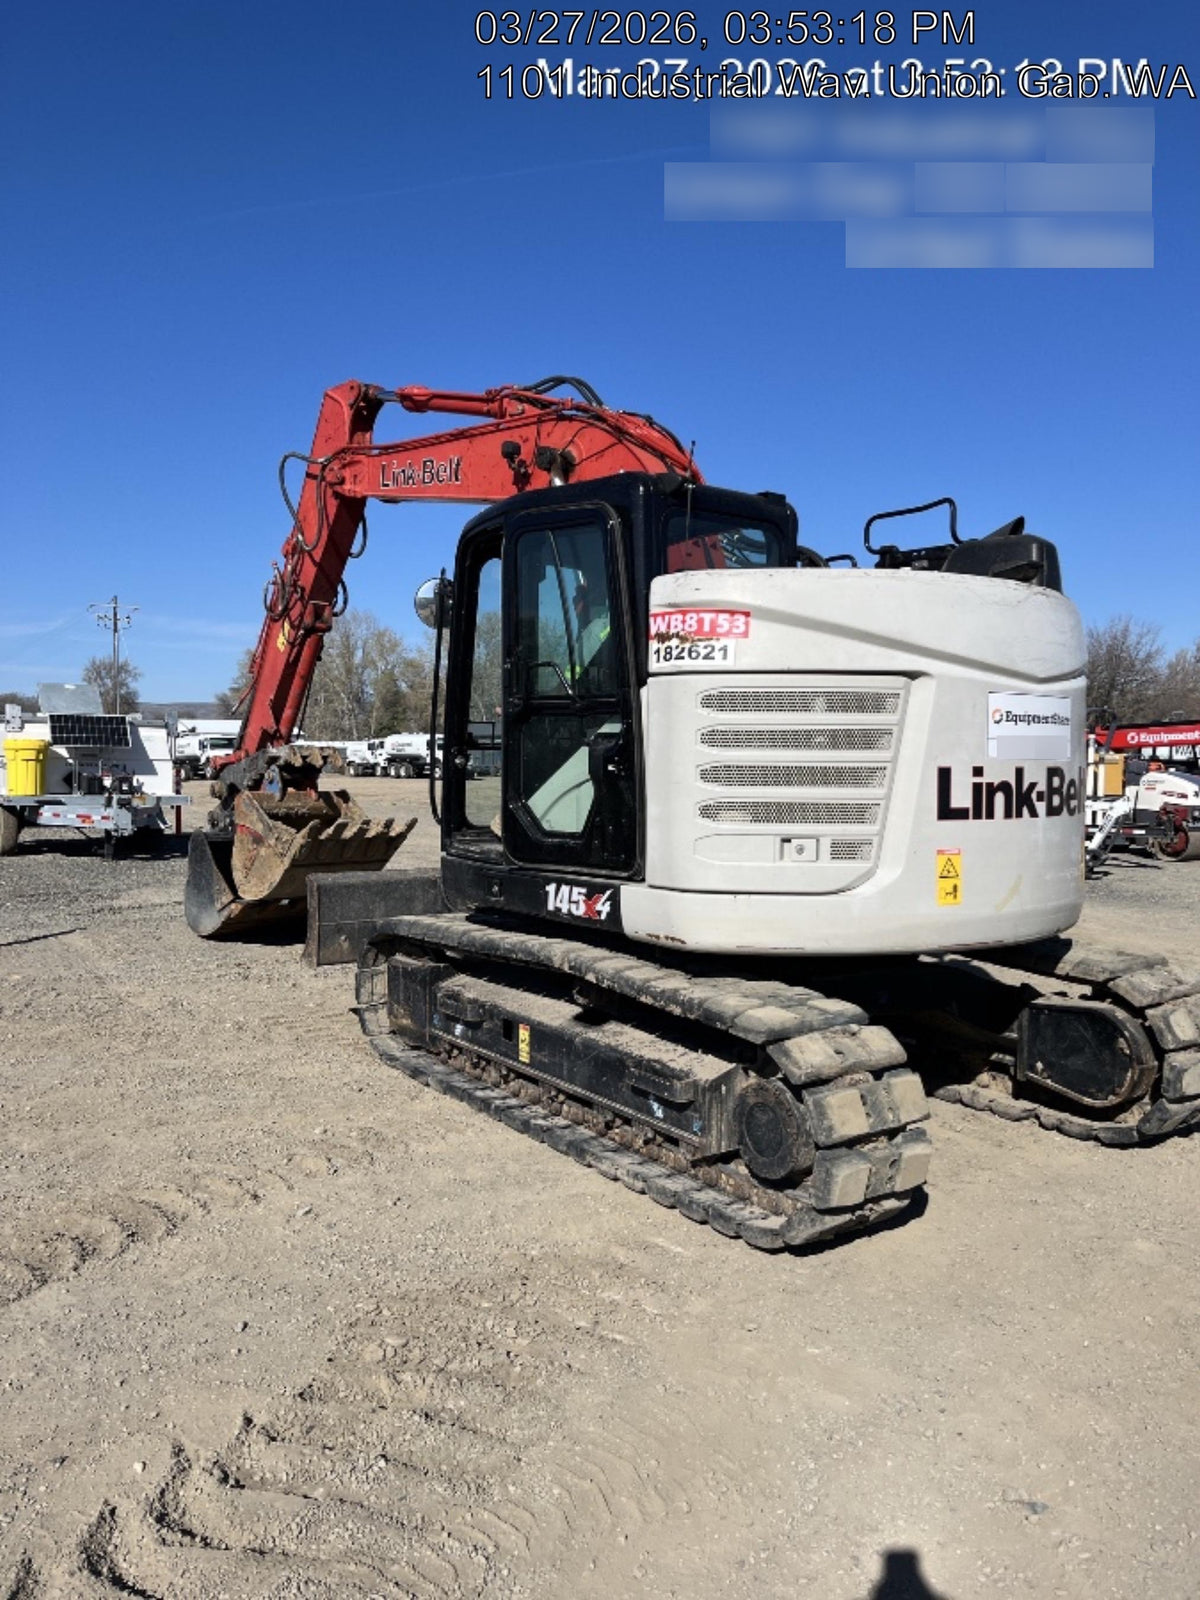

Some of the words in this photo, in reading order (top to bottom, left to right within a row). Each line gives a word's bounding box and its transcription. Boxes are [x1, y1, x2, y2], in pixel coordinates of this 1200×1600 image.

[380, 456, 462, 489] Link-Belt
[650, 612, 747, 635] WB8T53
[653, 644, 729, 663] 182621
